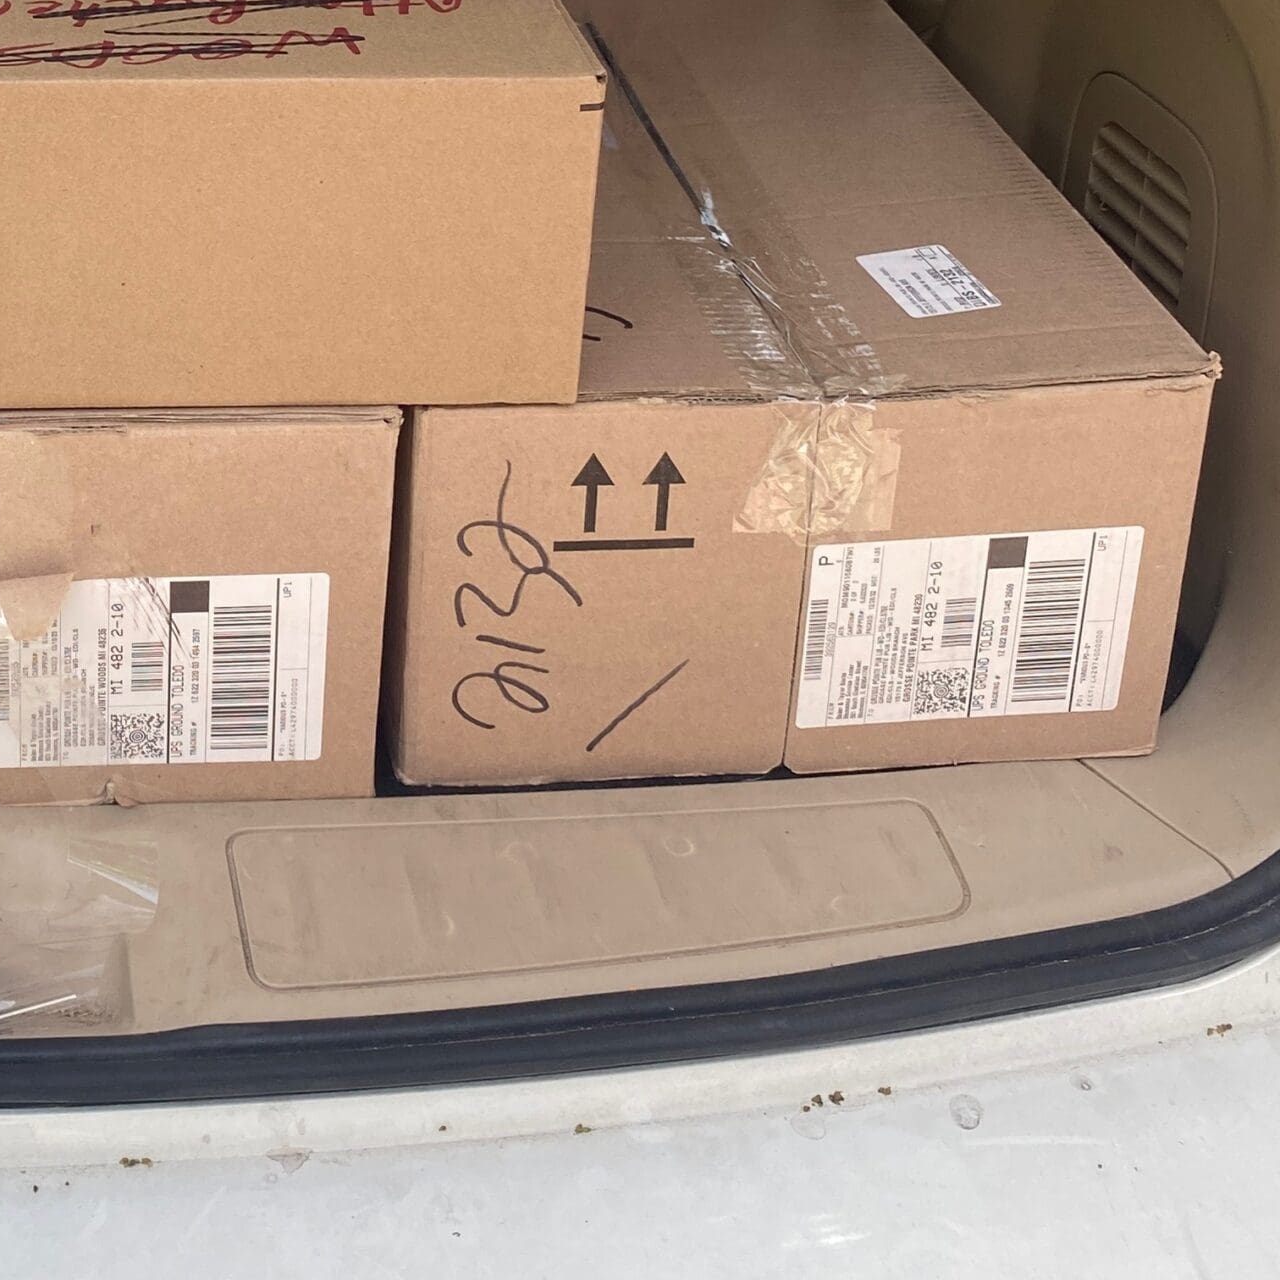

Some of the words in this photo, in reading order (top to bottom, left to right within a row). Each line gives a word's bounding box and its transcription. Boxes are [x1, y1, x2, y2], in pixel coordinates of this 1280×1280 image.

[817, 555, 835, 566] P
[283, 581, 292, 597] UP1
[926, 560, 943, 594] 2-10
[110, 602, 124, 637] 2-10
[922, 601, 938, 625] 482
[908, 626, 919, 645] PARK
[919, 635, 934, 651] MI
[978, 619, 994, 652] TOLEDO
[97, 650, 106, 660] MI
[110, 644, 123, 669] 482
[905, 647, 917, 672] POINTE
[97, 661, 106, 688] WOODS
[171, 664, 184, 698] TOLEDO
[973, 656, 990, 689] GROUND
[110, 679, 122, 694] MI
[902, 674, 914, 702] GROSSE
[971, 694, 985, 711] UPS
[170, 703, 183, 736] GROUND
[170, 740, 182, 758] UPS
